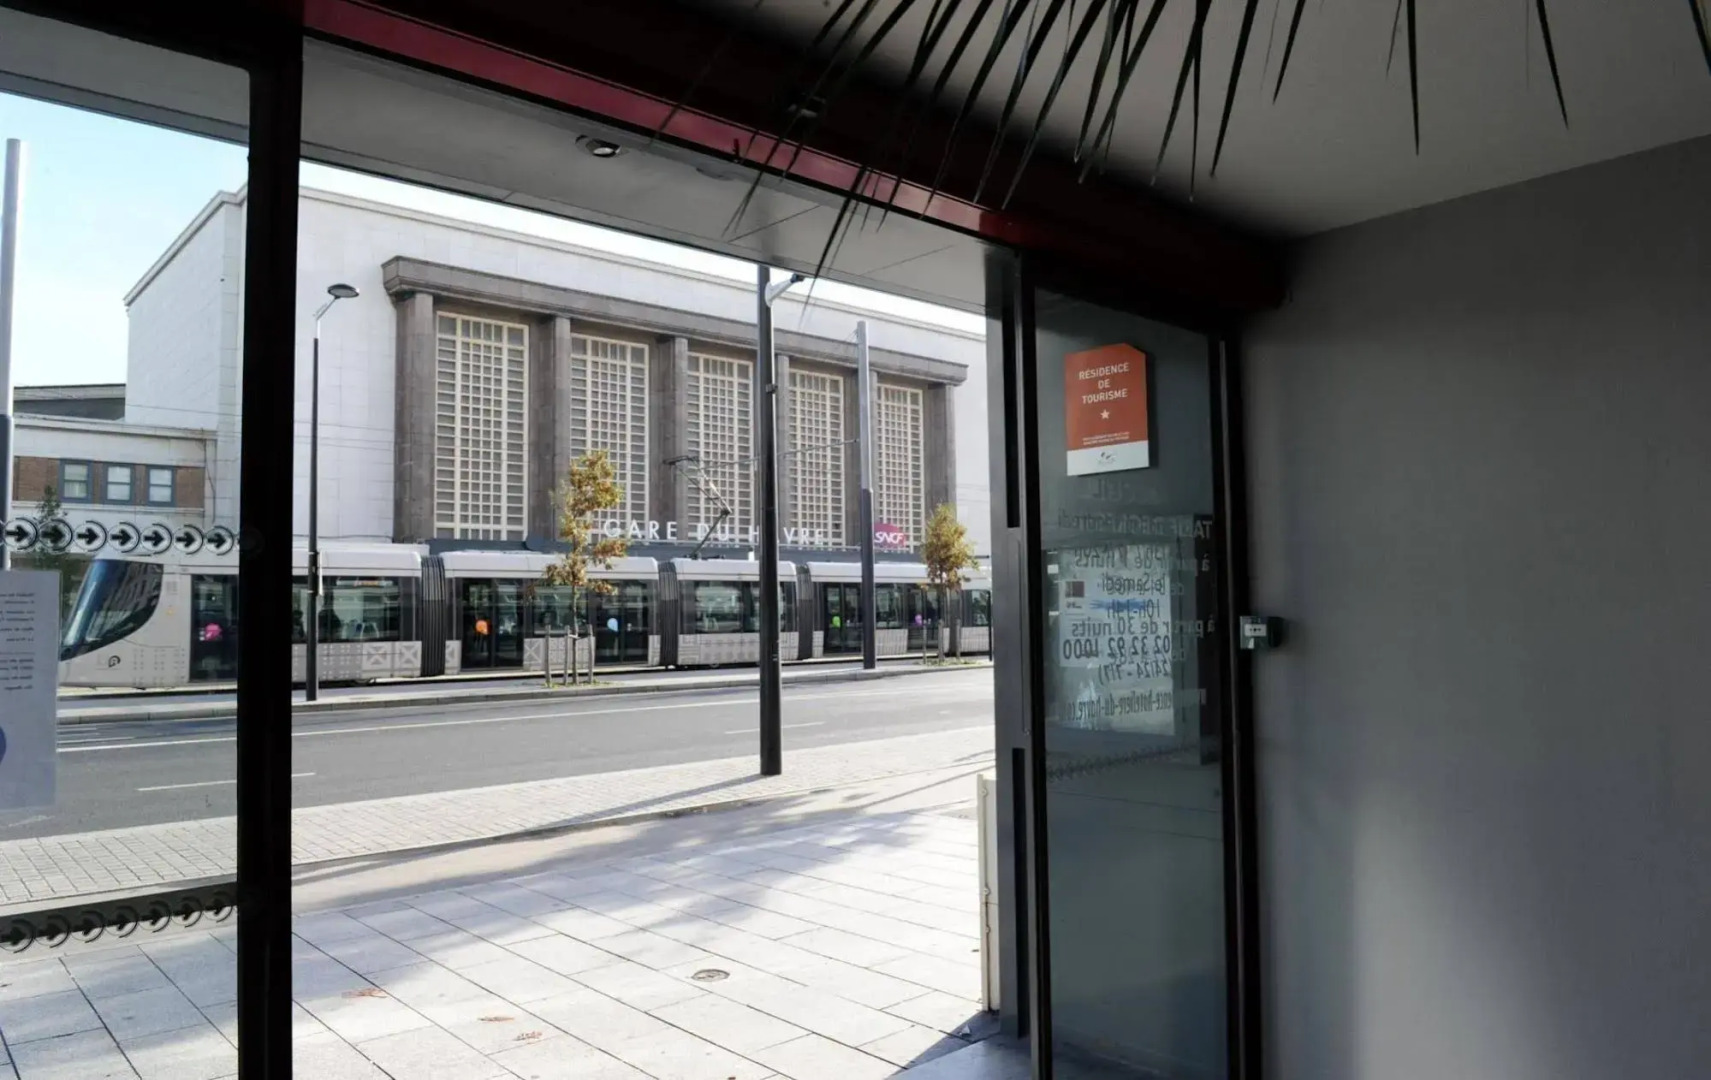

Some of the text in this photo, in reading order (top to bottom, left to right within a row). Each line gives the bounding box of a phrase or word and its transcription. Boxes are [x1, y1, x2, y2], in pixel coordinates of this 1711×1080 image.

[1097, 379, 1110, 390] DE
[1082, 388, 1128, 405] TOURISME
[603, 518, 825, 546] GARE DU HVRE
[874, 531, 905, 544] SNCF
